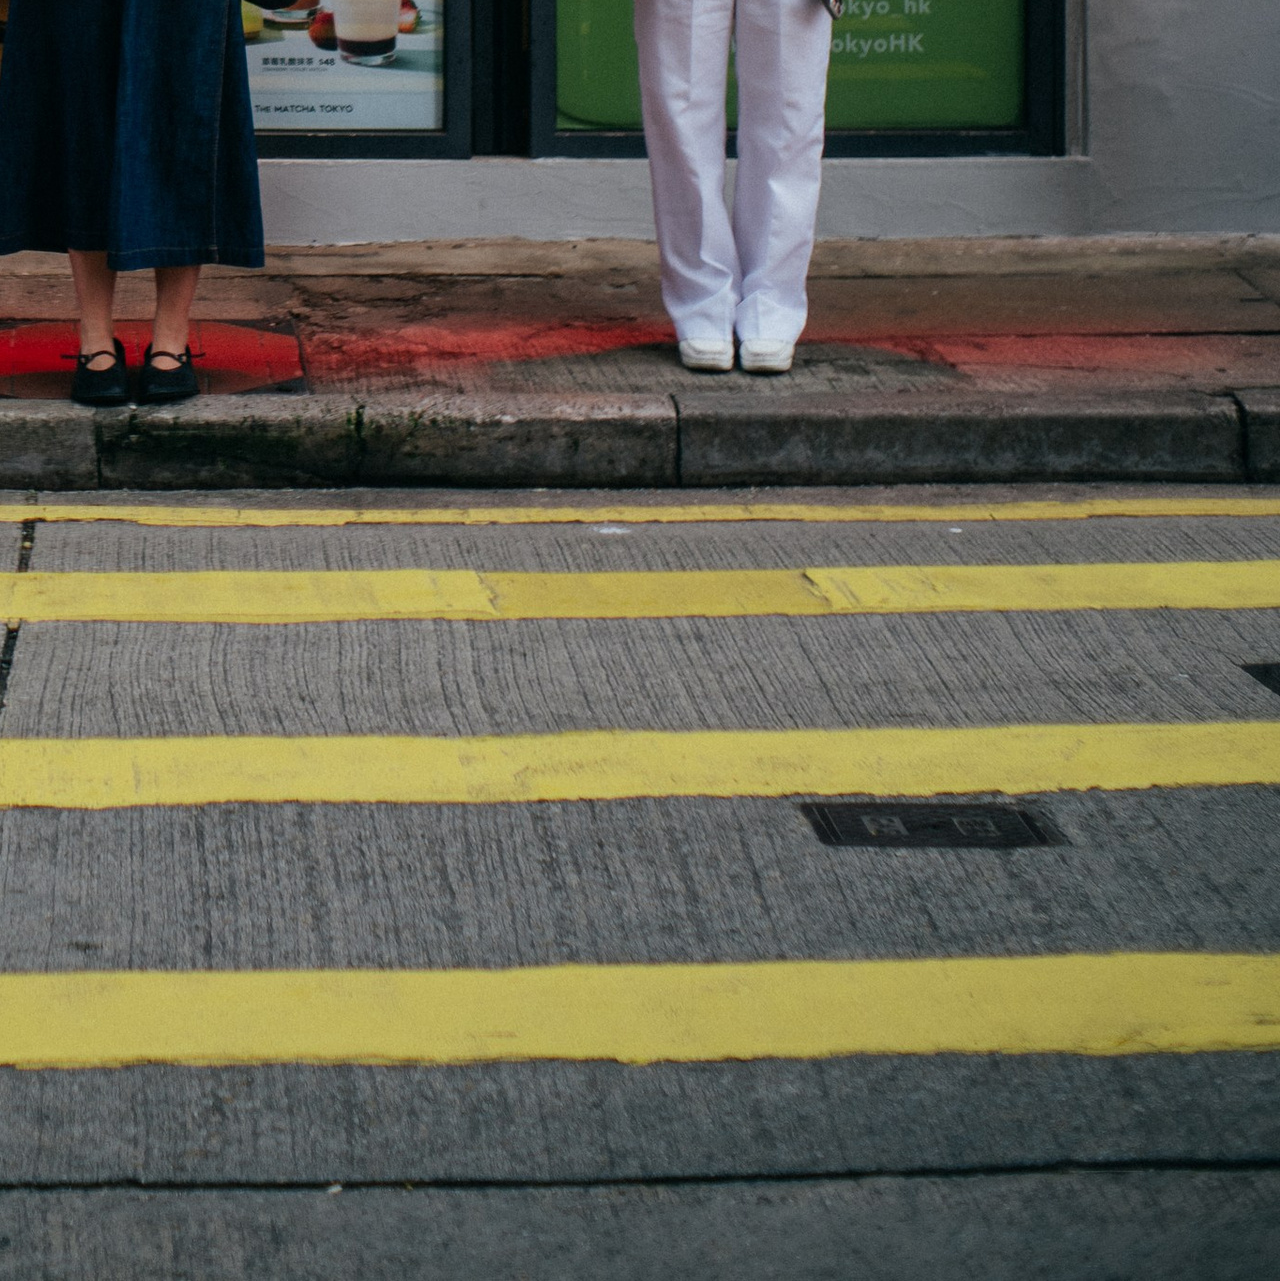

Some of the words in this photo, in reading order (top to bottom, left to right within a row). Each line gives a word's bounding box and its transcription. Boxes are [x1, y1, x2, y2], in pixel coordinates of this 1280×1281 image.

[831, 33, 925, 58] okyoHK
[319, 57, 335, 66] $48
[255, 104, 271, 113] THE
[274, 104, 316, 113] MATCHA
[319, 104, 354, 113] TOKYO
